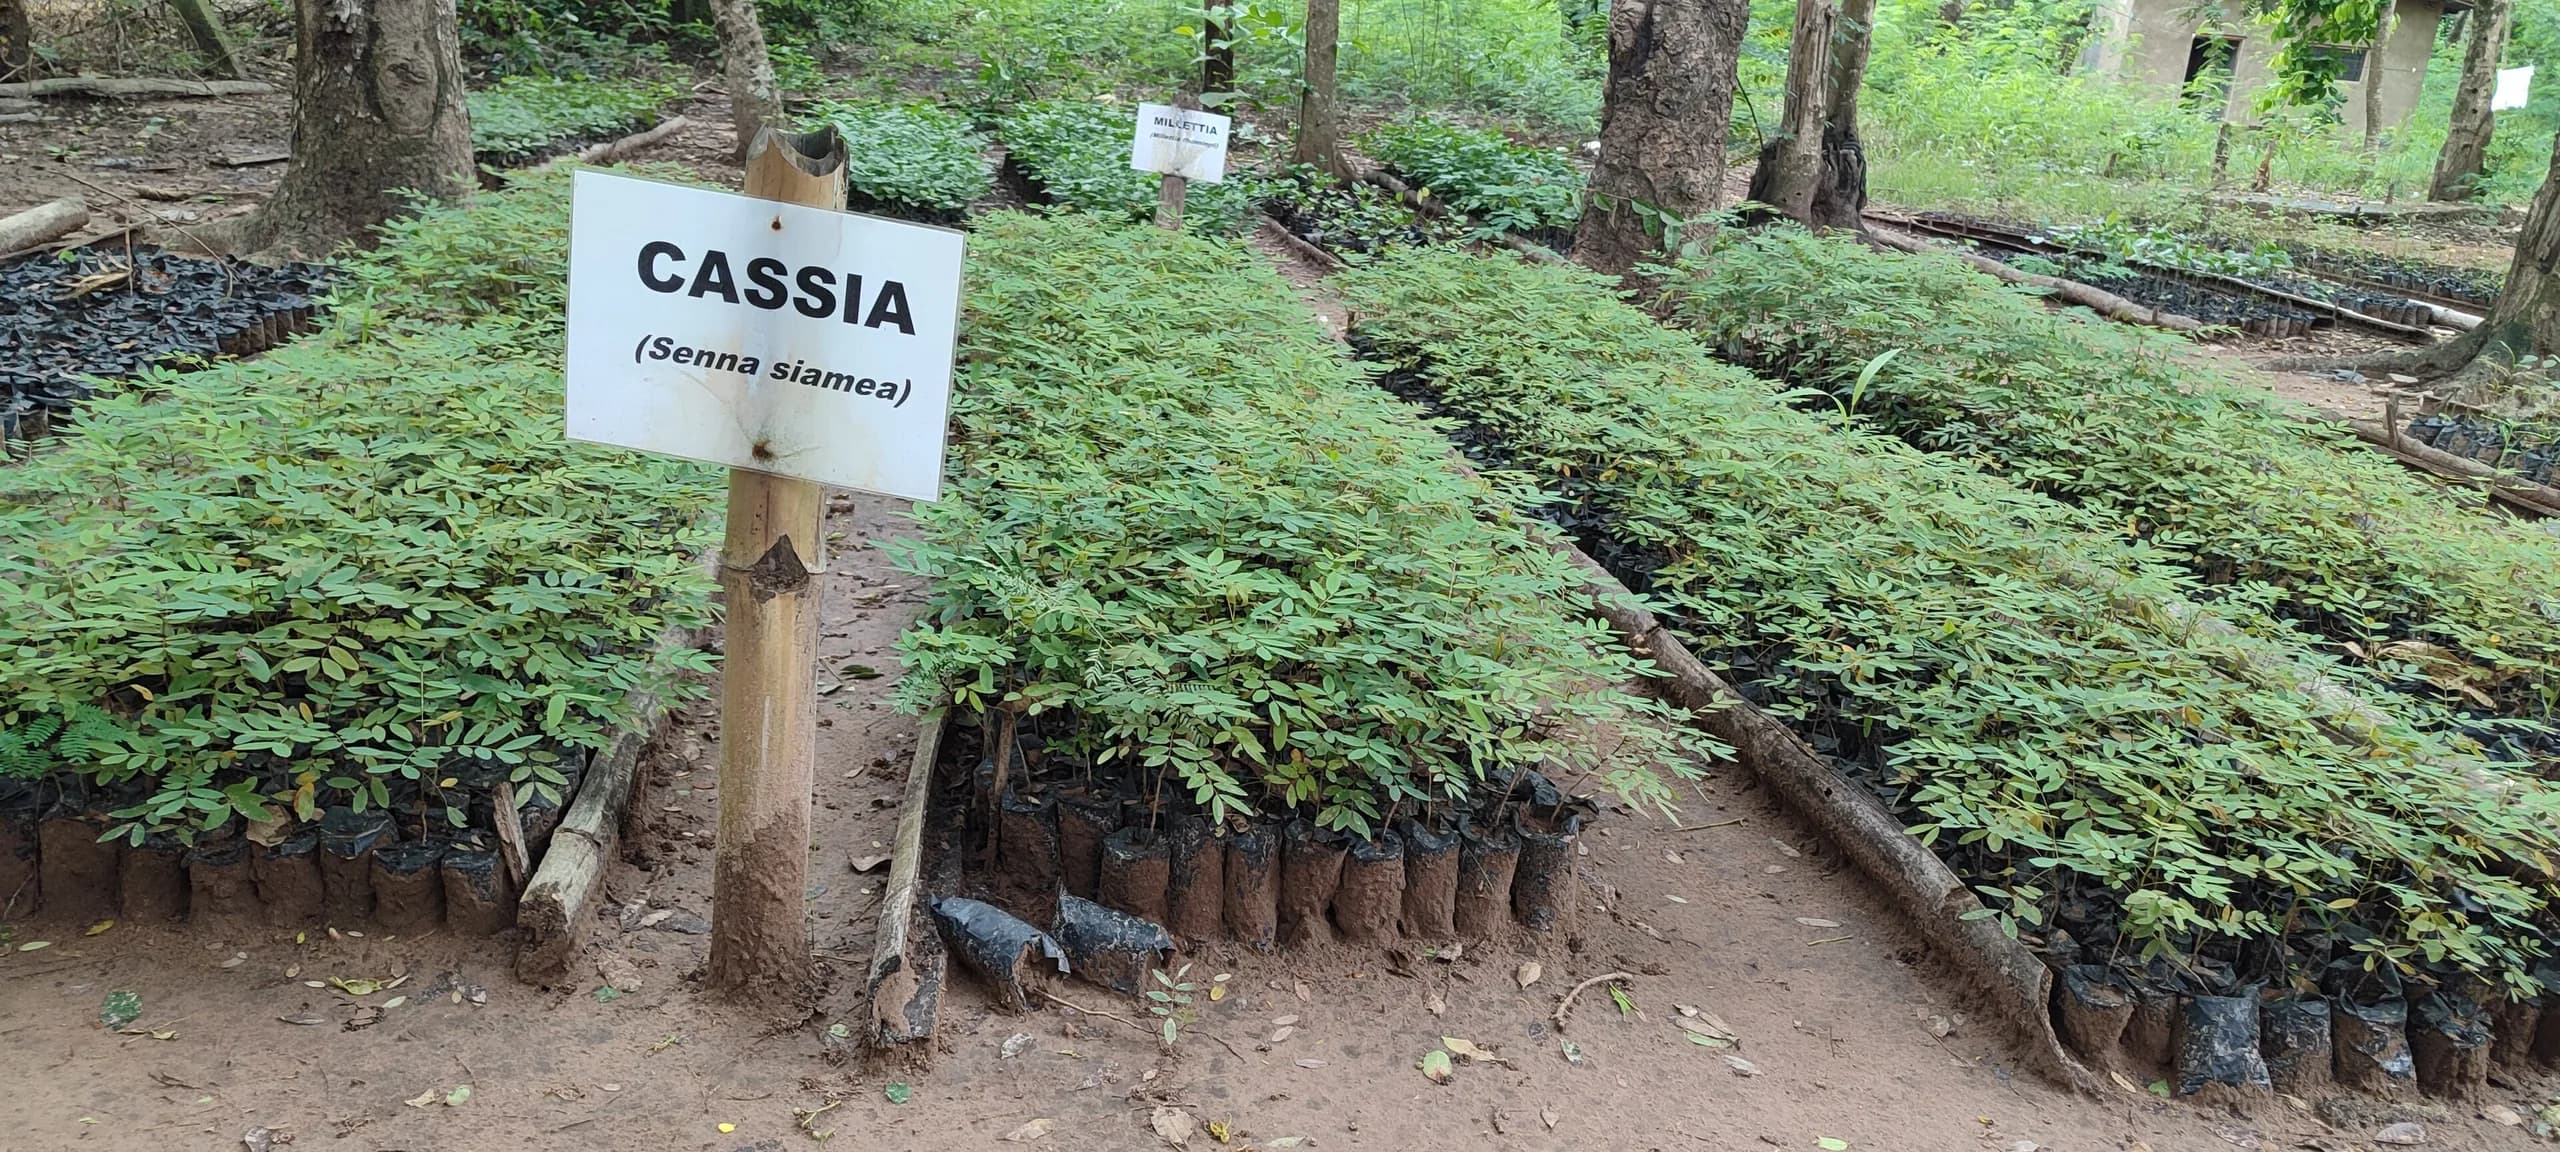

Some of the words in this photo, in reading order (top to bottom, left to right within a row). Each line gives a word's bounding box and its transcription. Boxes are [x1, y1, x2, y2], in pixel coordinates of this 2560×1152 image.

[637, 241, 915, 335] CASSIA
[635, 334, 760, 375] (Senna
[769, 358, 912, 408] siamea)
